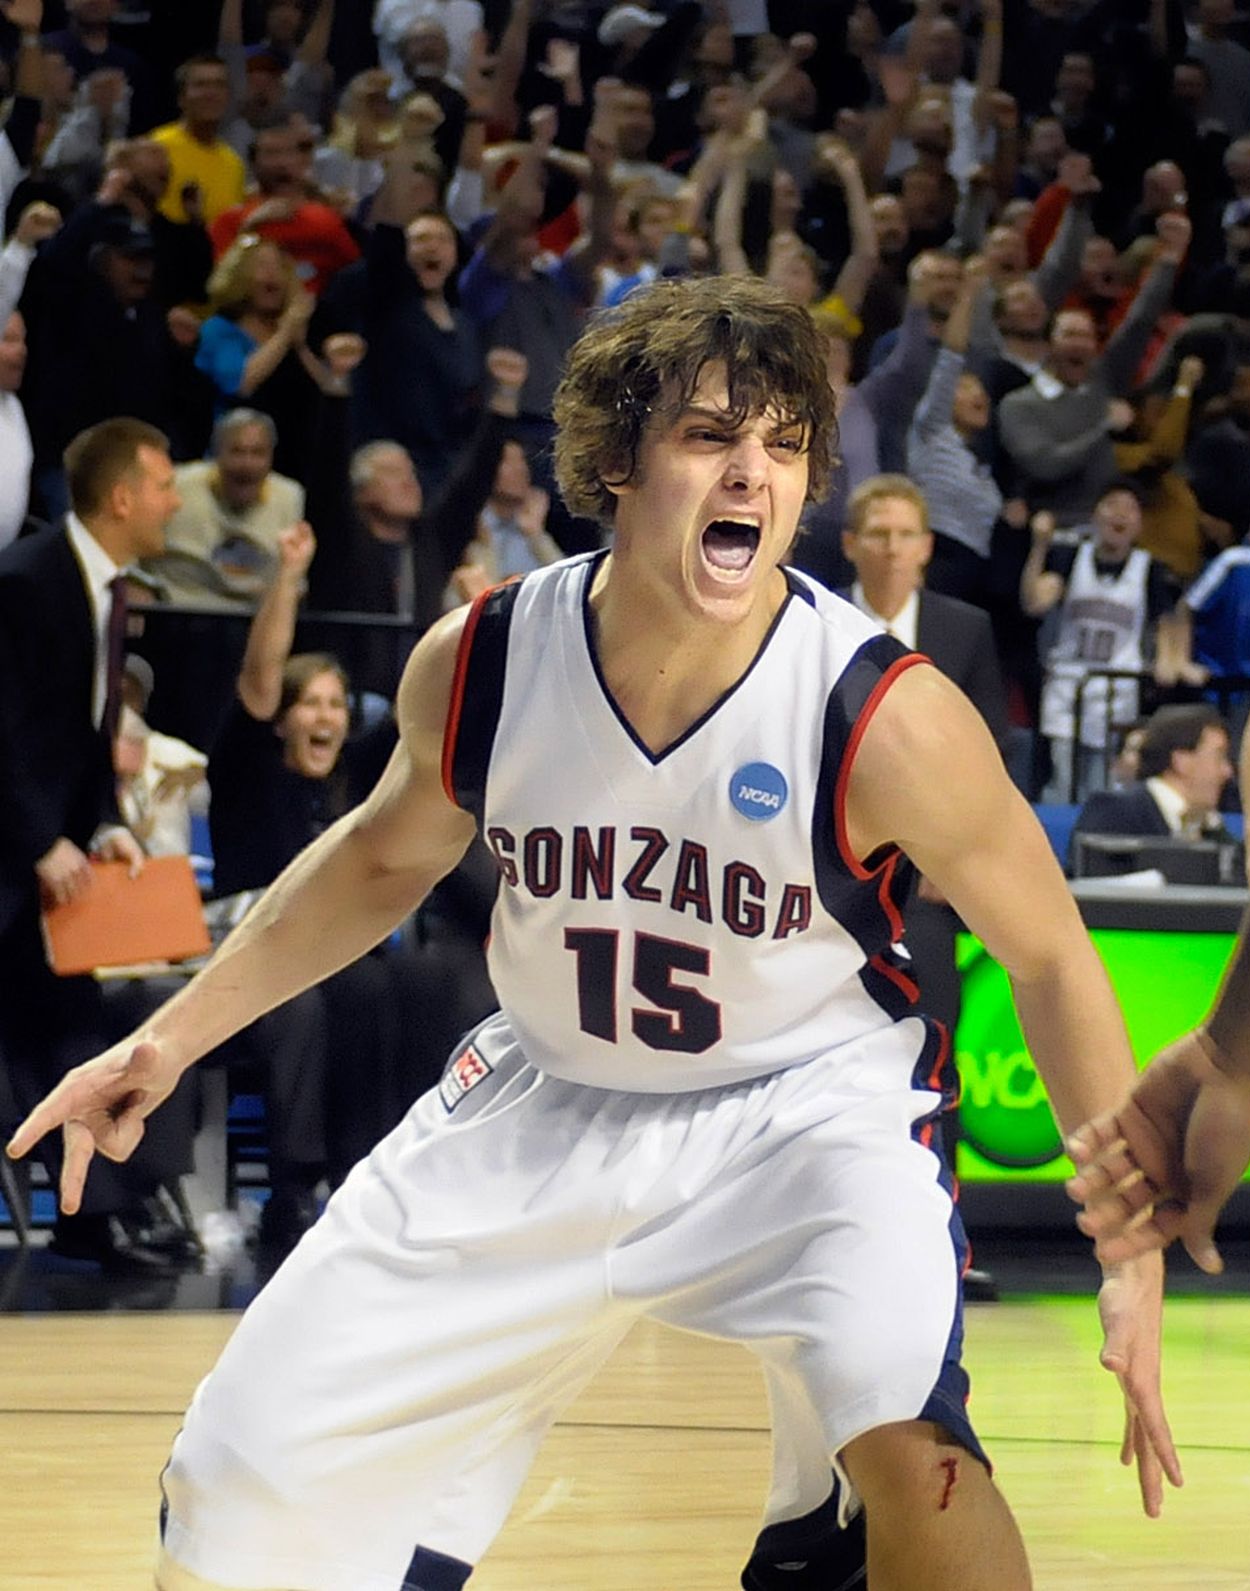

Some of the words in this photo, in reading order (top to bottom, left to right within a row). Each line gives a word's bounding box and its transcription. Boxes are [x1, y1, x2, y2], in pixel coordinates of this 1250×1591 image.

[738, 785, 780, 809] NCAA
[487, 826, 812, 940] GONZAGA
[564, 927, 722, 1054] 15
